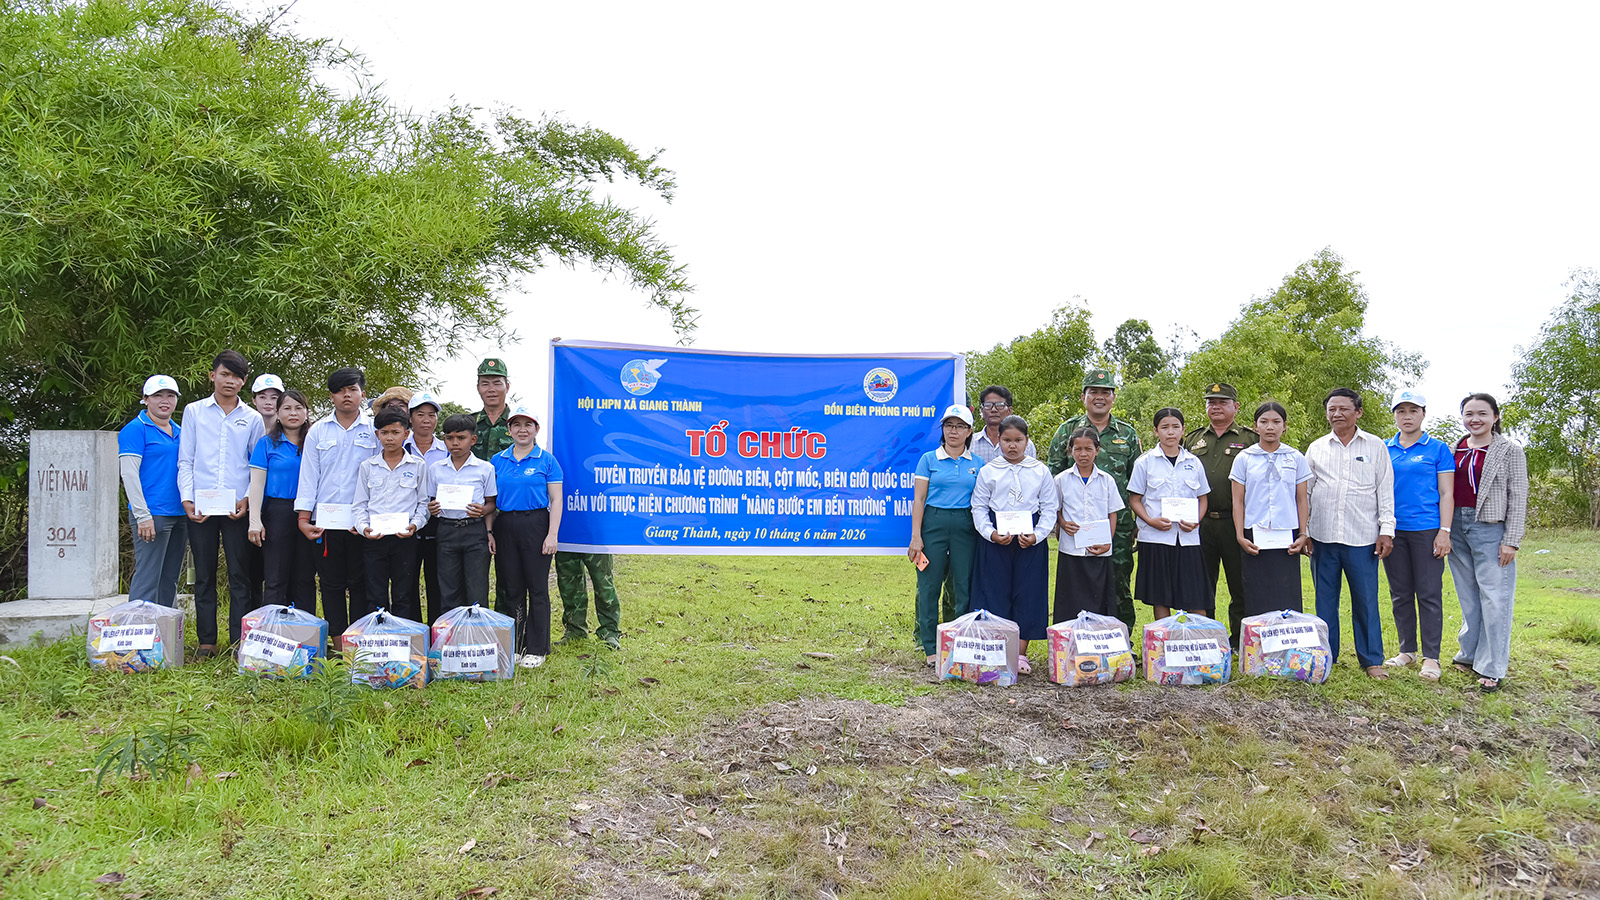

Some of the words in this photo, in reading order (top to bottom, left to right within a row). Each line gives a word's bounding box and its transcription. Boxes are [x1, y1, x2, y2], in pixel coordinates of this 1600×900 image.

[578, 396, 594, 411] HỘI
[596, 399, 621, 410] LHPN
[624, 398, 637, 410] XÃ
[639, 400, 668, 410] GIANG
[671, 399, 702, 412] THÀNH
[846, 403, 866, 416] BIÊN
[869, 404, 900, 416] PHÒNG
[902, 405, 920, 417] PHÚ
[922, 406, 936, 417] MỸ
[686, 420, 729, 458] TỔ
[738, 426, 826, 459] CHỨC
[38, 463, 60, 497] VIỆT
[62, 470, 88, 491] NAM
[594, 464, 626, 484] TUYÊN
[629, 463, 668, 485] TRUYỀN
[670, 463, 690, 486] BẢO
[694, 466, 706, 489] VỆ
[708, 466, 743, 486] ĐƯỜNG
[745, 467, 772, 488] BIÊN,
[775, 468, 794, 490] CỘT
[796, 466, 822, 489] MỐC,
[824, 468, 847, 488] BIÊN
[850, 468, 869, 488] GIỚI
[872, 467, 898, 490] QUỐC
[900, 472, 915, 489] GIA
[567, 489, 588, 512] GẮN
[590, 492, 607, 512] VỚI
[610, 494, 636, 516] THỰC
[638, 493, 663, 516] HIỆN
[665, 495, 706, 514] CHƯƠNG
[709, 494, 738, 514] TRÌNH
[778, 494, 804, 515] BƯỚC
[807, 498, 822, 515] EM
[825, 494, 845, 516] ĐẾN
[47, 527, 77, 542] 304
[645, 526, 679, 541] Giang
[682, 526, 721, 540] Thành,
[724, 528, 751, 541] ngày
[754, 528, 766, 539] 10
[769, 528, 801, 542] tháng
[804, 528, 810, 540] 6
[813, 529, 837, 540] năm
[840, 529, 866, 540] 2026
[58, 548, 65, 558] 8
